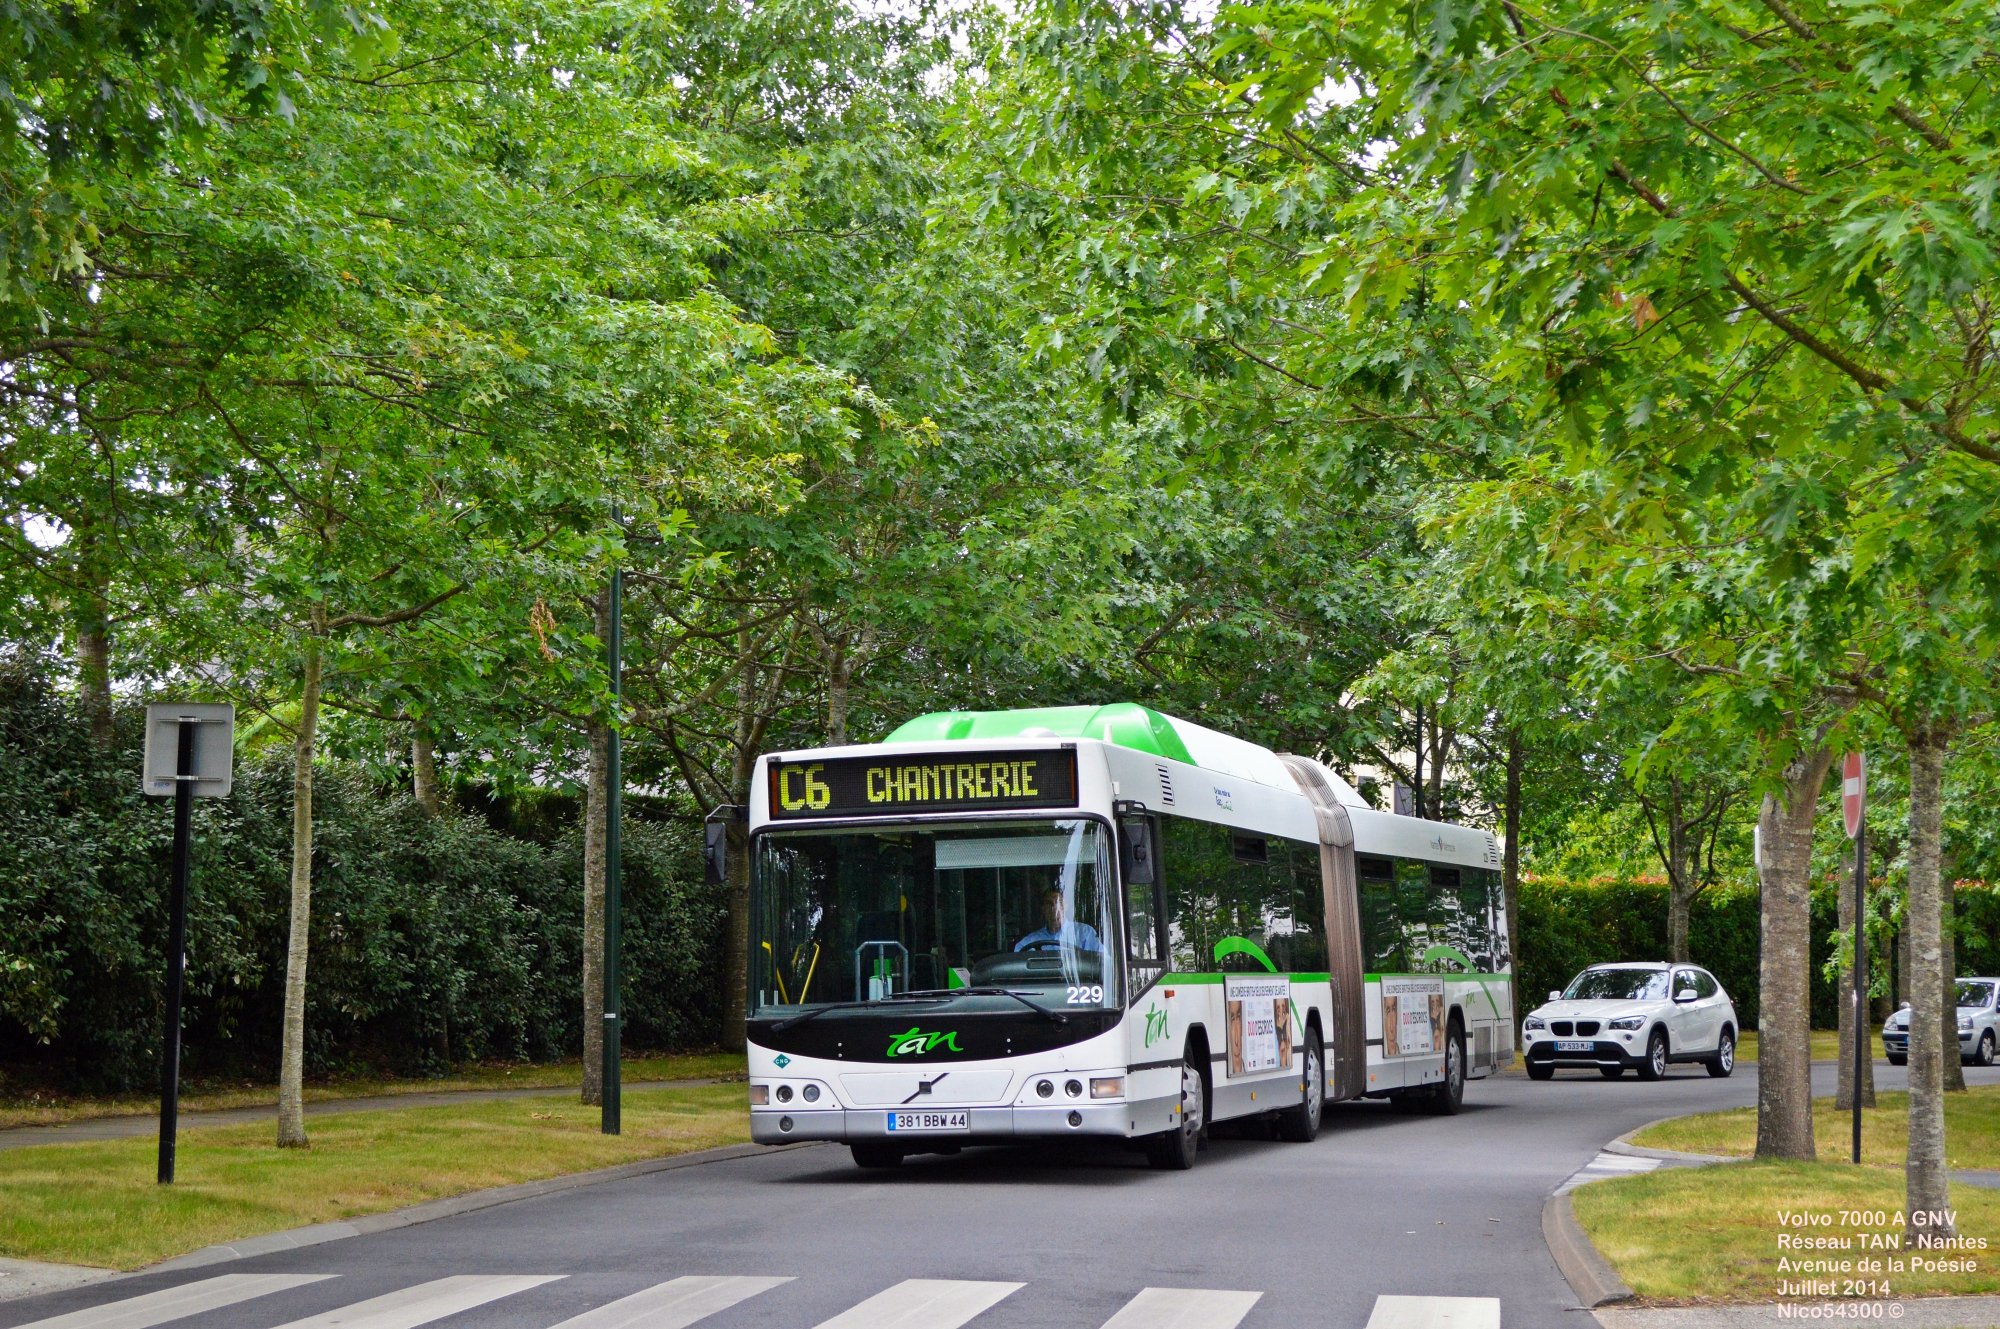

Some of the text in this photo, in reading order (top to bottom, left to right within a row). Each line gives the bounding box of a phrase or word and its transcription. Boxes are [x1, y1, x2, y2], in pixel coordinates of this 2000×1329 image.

[780, 761, 1038, 811] C6 CHANTRERIE
[1067, 986, 1103, 1004] 229
[887, 1027, 964, 1057] tan
[898, 1114, 965, 1128] 381 BBW 44
